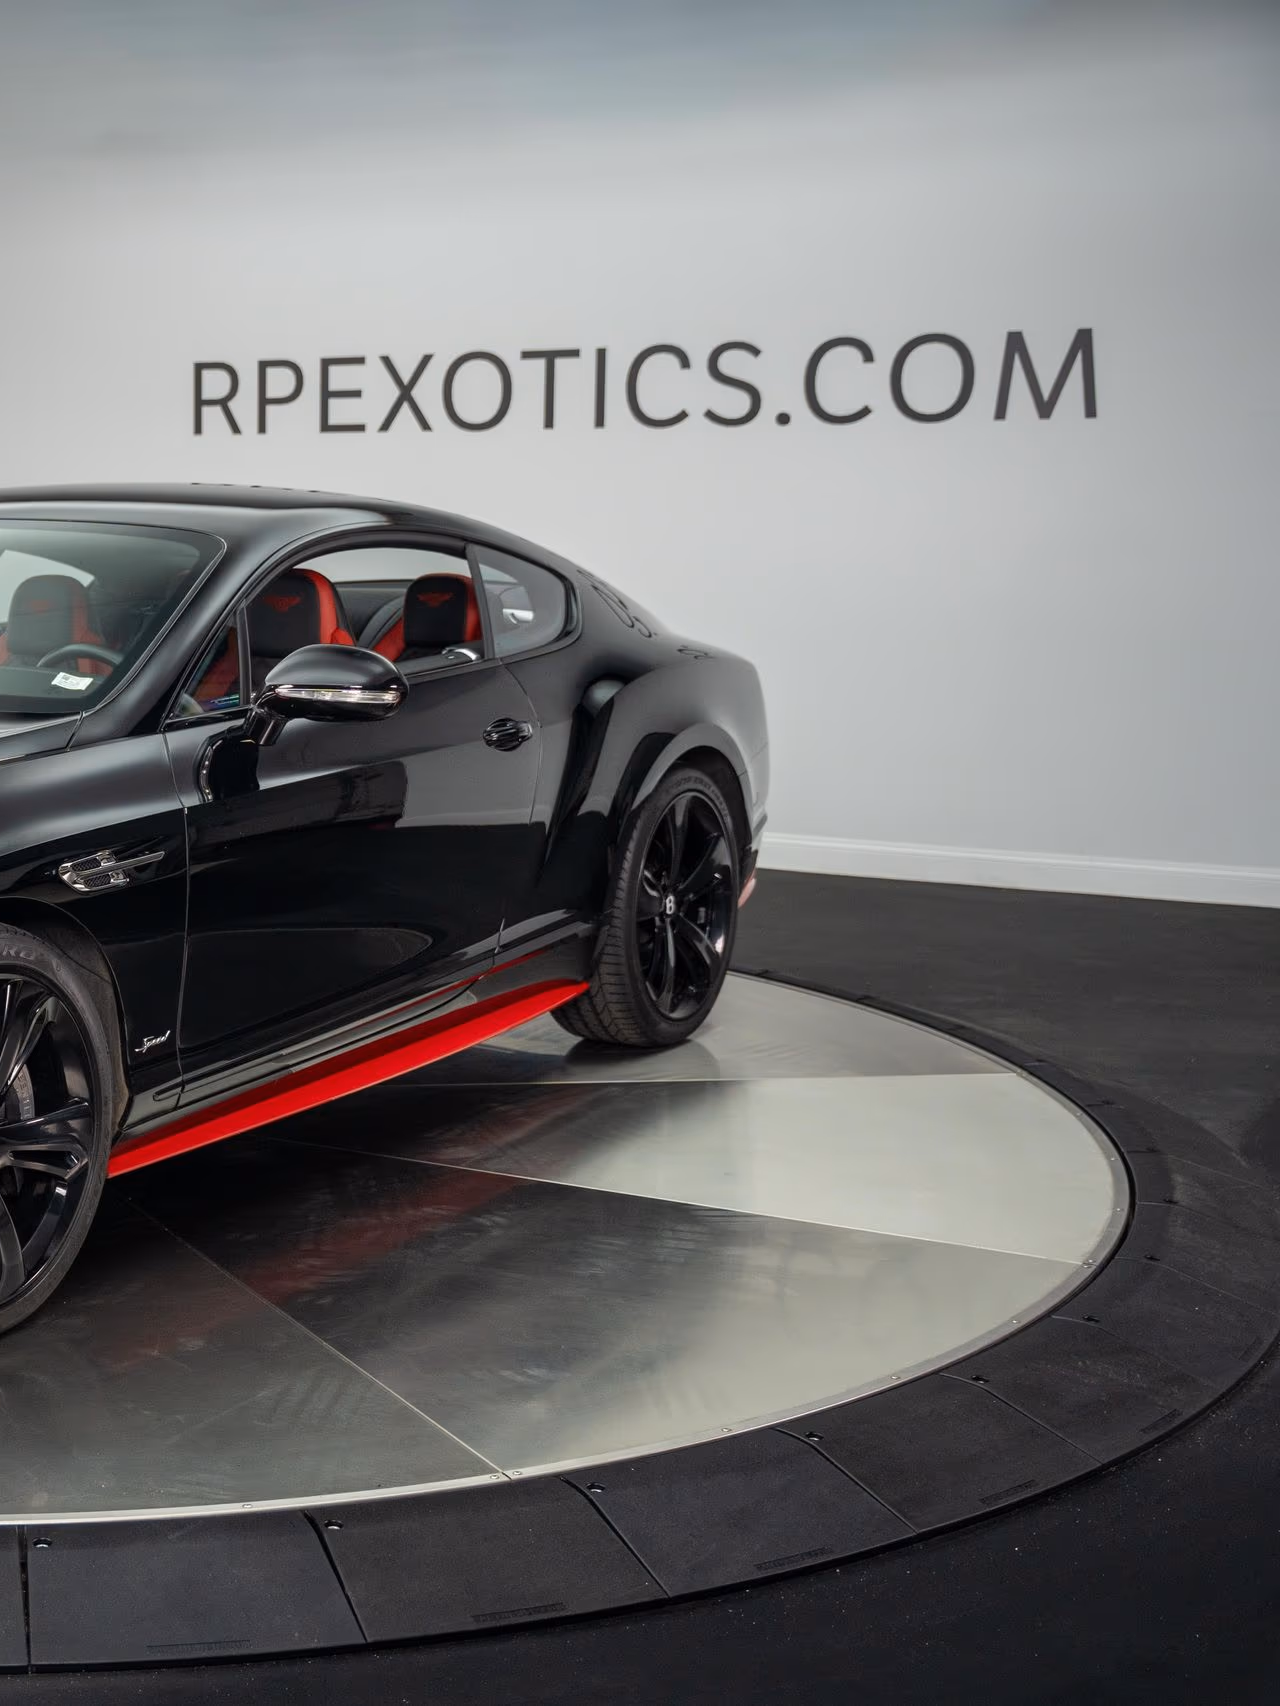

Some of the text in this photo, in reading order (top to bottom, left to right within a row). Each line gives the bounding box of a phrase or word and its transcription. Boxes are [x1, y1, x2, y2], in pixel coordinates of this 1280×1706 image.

[193, 327, 1097, 435] RPEXOTICS.COM
[665, 895, 675, 915] B
[134, 1030, 171, 1053] Speed
